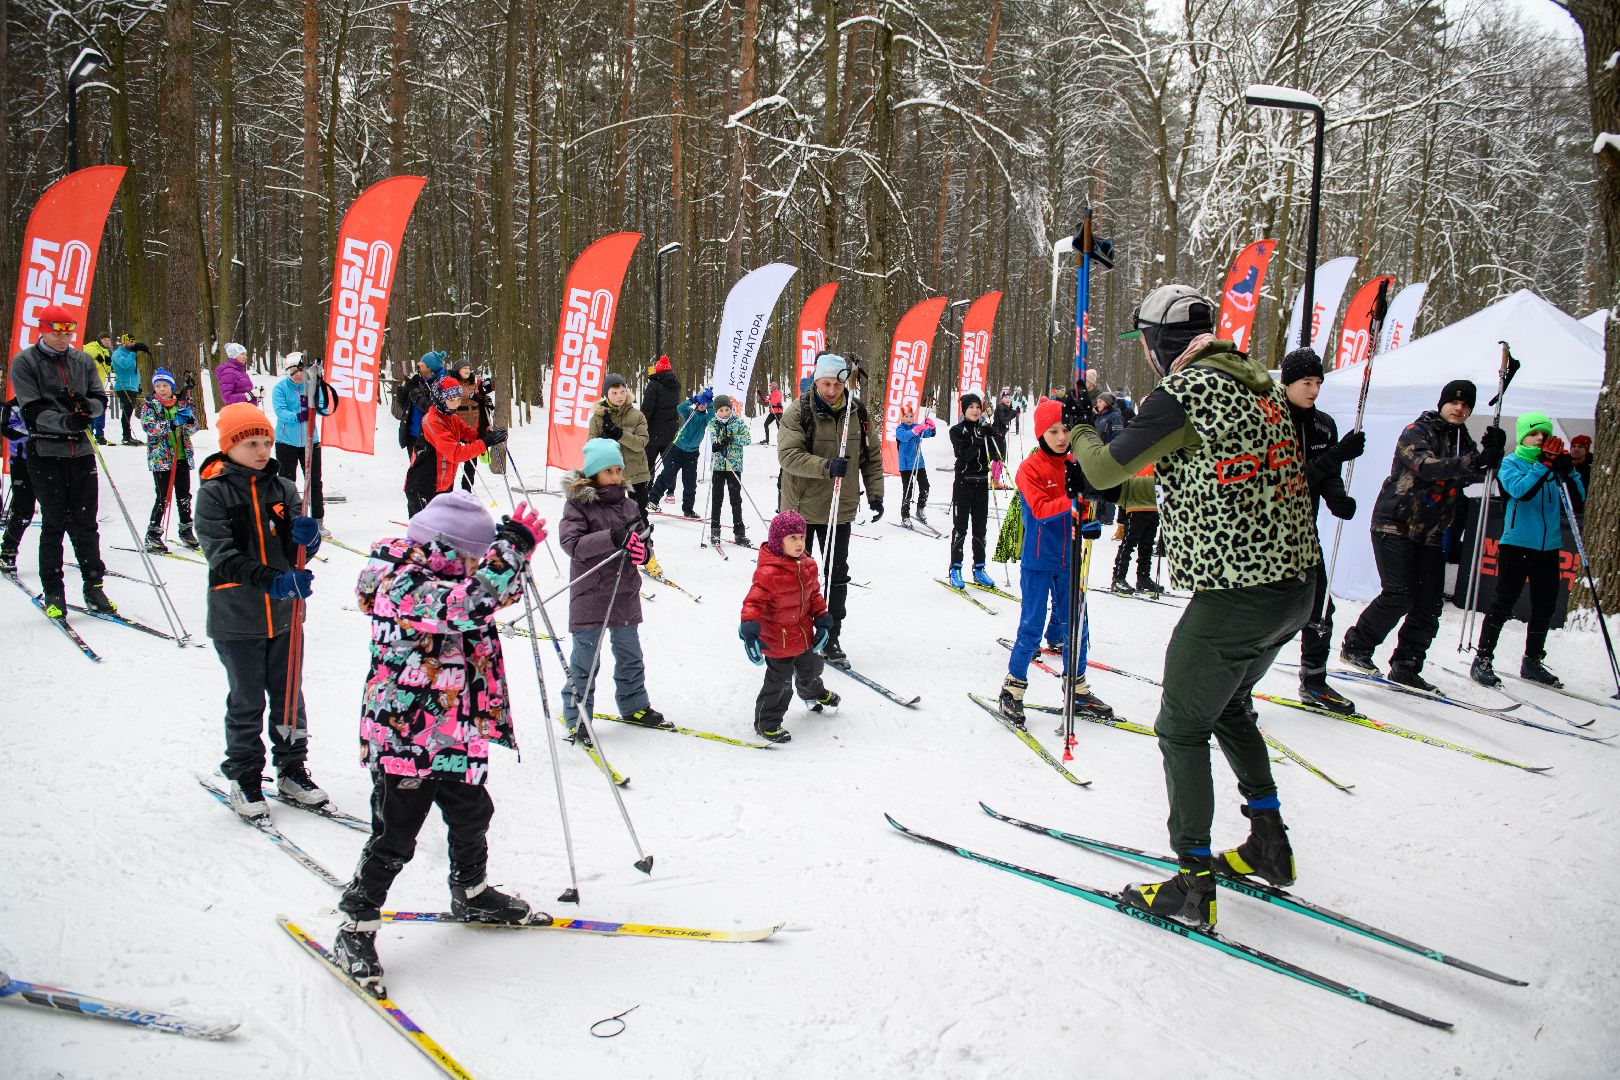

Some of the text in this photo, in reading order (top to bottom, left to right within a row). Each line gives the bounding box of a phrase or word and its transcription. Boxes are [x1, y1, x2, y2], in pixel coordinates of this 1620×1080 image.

[329, 237, 368, 399] МОСОБЛ
[353, 277, 386, 403] СПОРТ
[553, 287, 591, 426] МОСОБЛ
[736, 313, 765, 391] ГУБЕРНАТОРА
[574, 322, 607, 429] СПОРТ
[885, 340, 911, 442] МОСОБЛ
[649, 927, 711, 938] FISCHER
